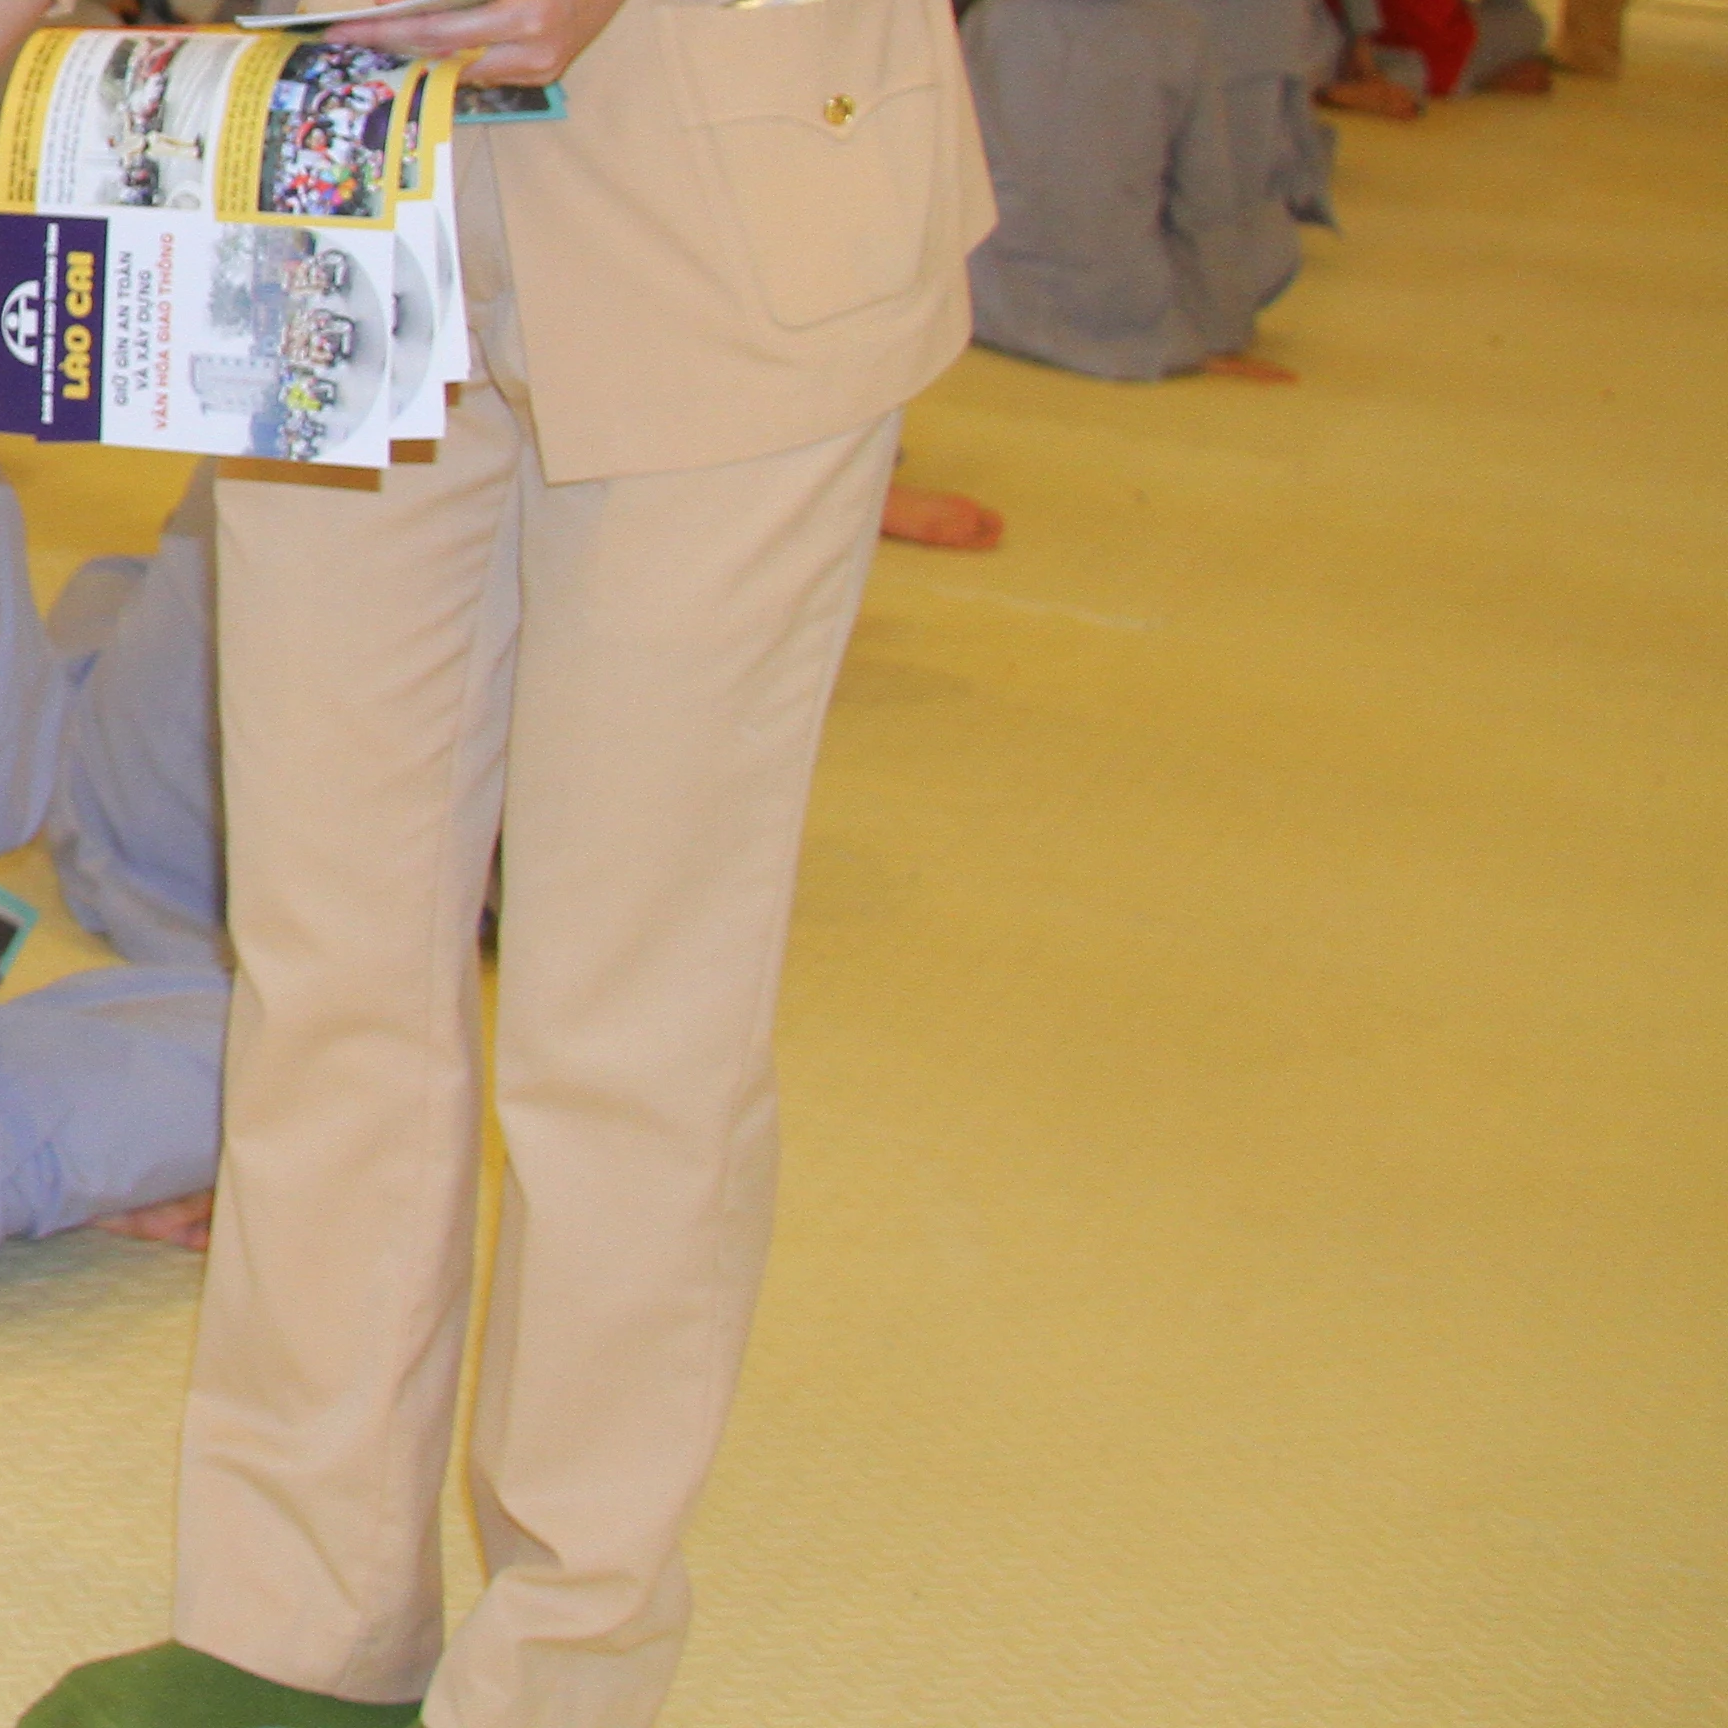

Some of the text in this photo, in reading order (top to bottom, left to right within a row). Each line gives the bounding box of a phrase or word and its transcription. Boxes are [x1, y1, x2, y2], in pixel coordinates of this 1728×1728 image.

[57, 250, 95, 400] LÀO CAI
[117, 304, 131, 330] AN
